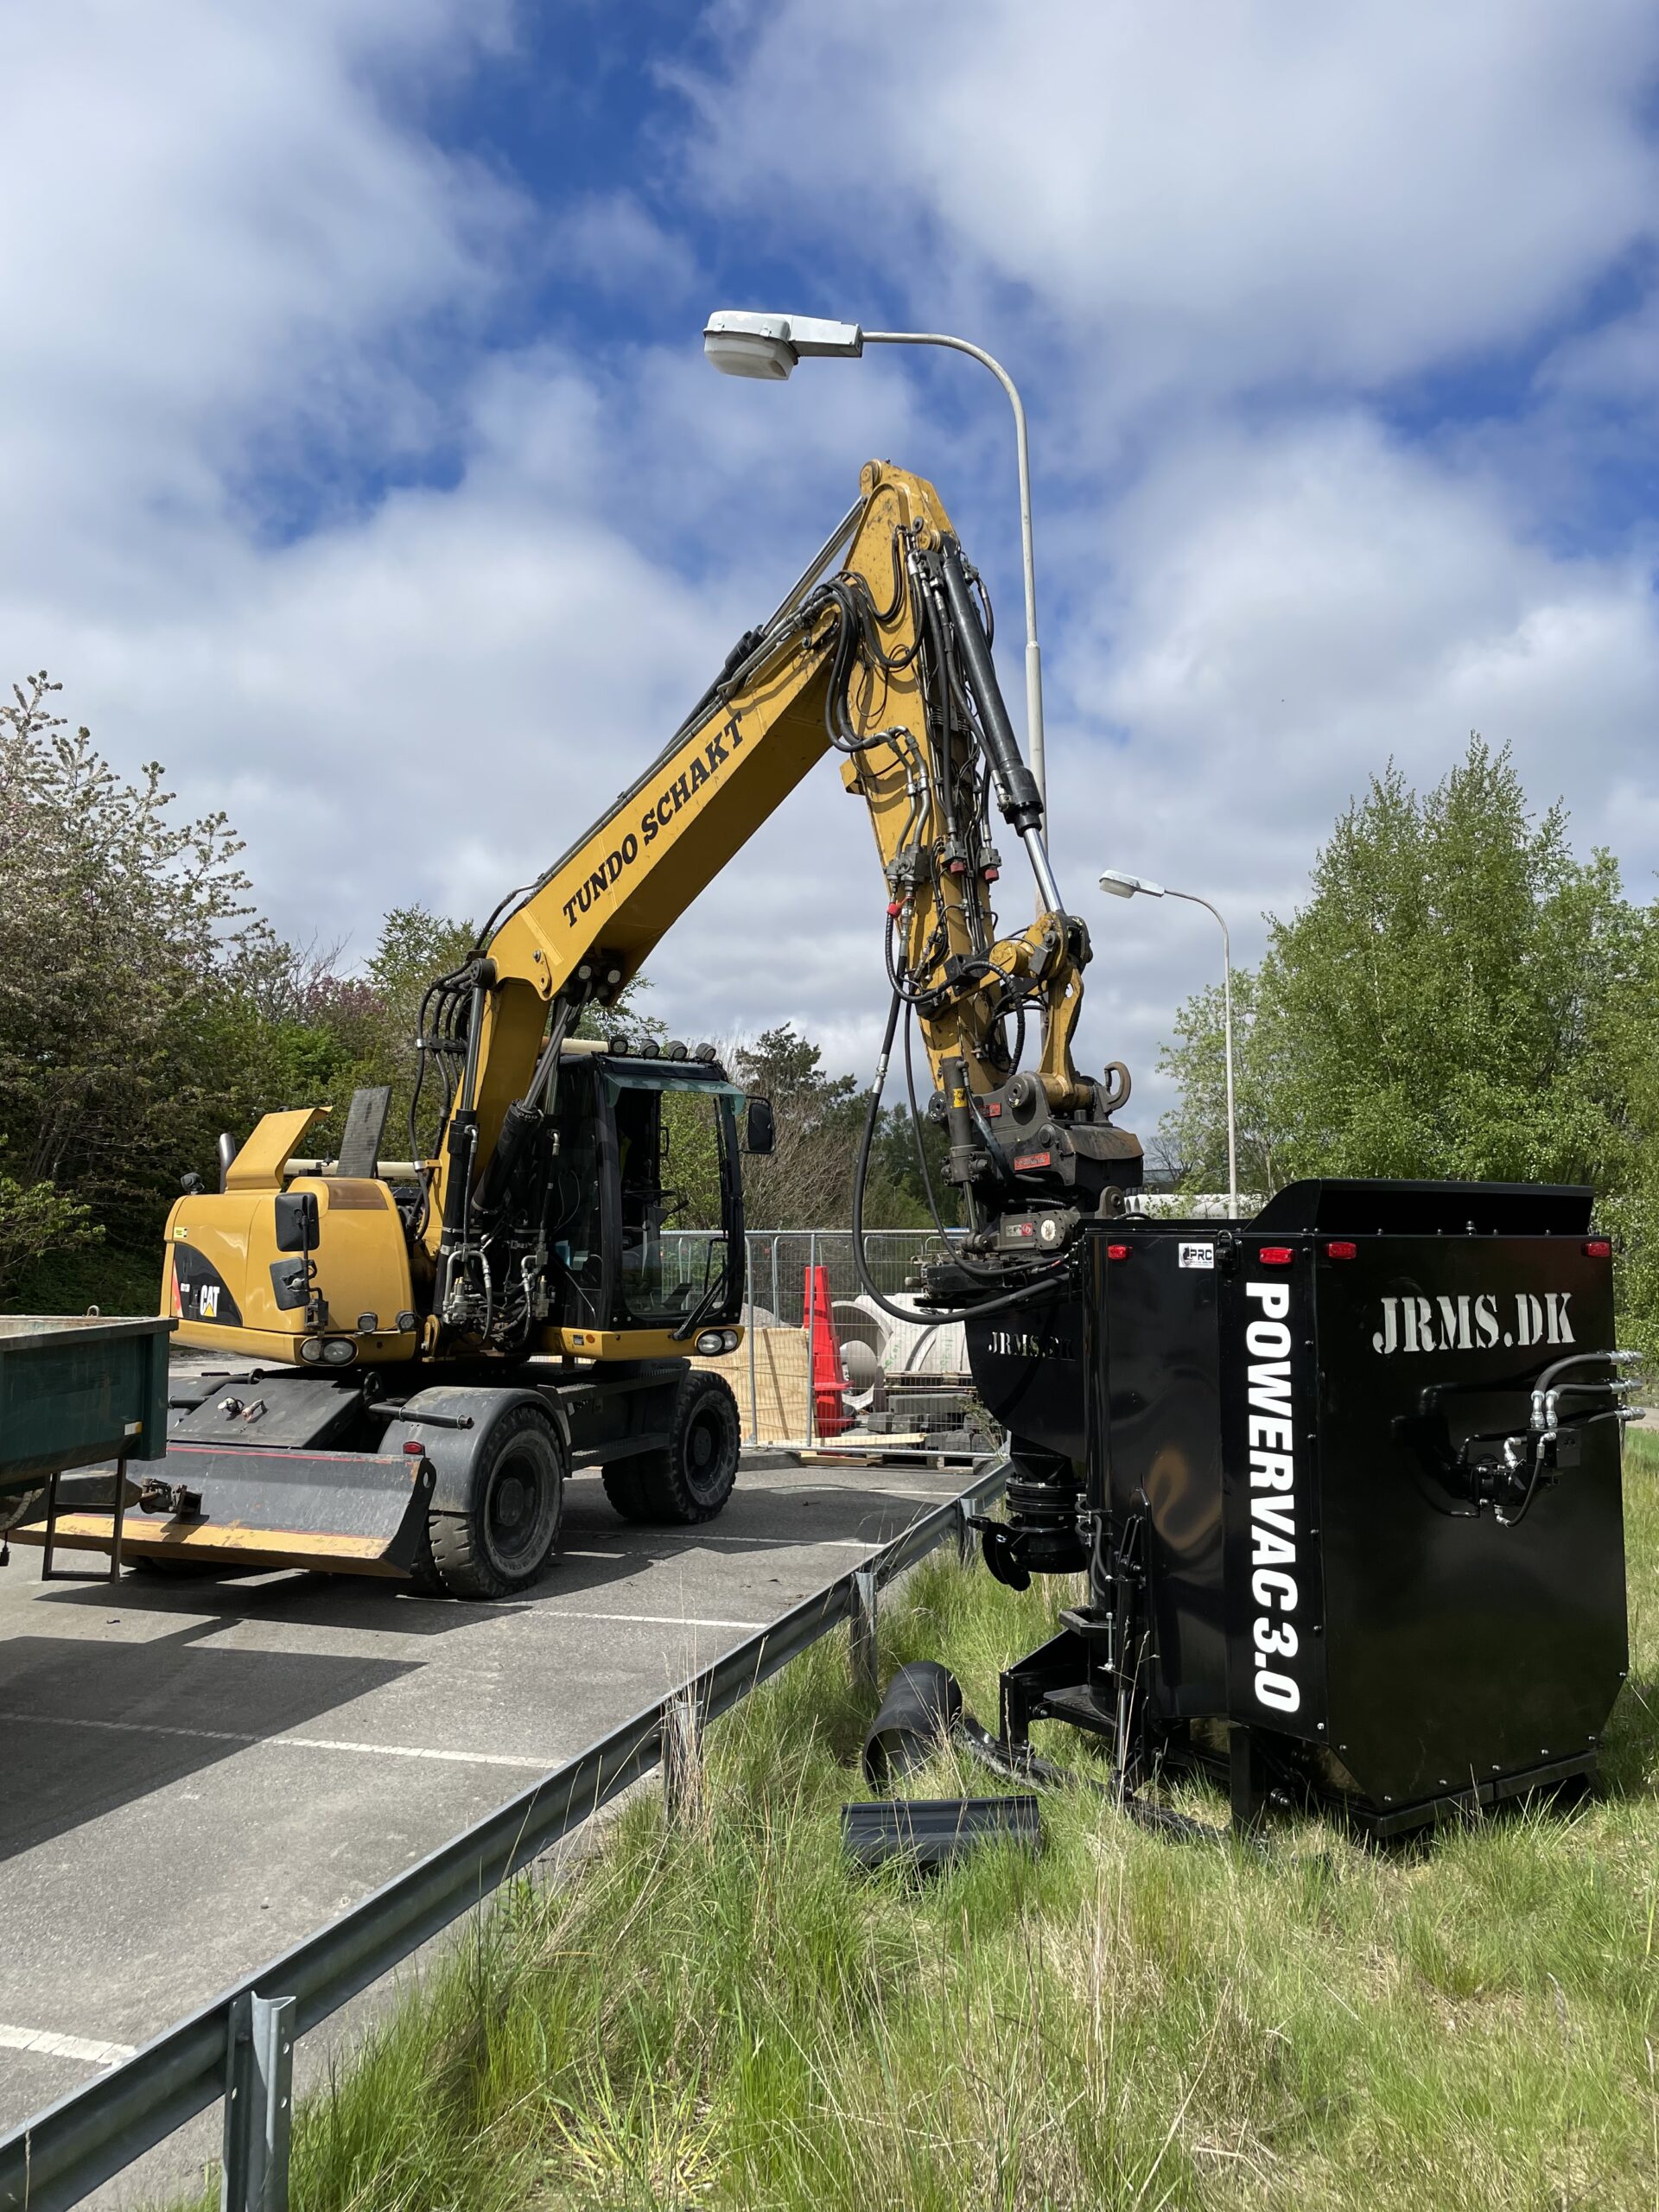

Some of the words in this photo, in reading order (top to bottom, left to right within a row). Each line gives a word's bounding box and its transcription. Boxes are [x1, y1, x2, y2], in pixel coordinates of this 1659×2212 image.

[563, 833, 638, 928] TUNDO
[641, 710, 743, 846] SCHAKT
[1190, 1249, 1212, 1261] PRC
[200, 1284, 220, 1318] CAT
[1372, 1293, 1577, 1355] JRMS.DK
[1245, 1281, 1299, 1612] POWERVAC
[1253, 1616, 1301, 1714] 3.0
